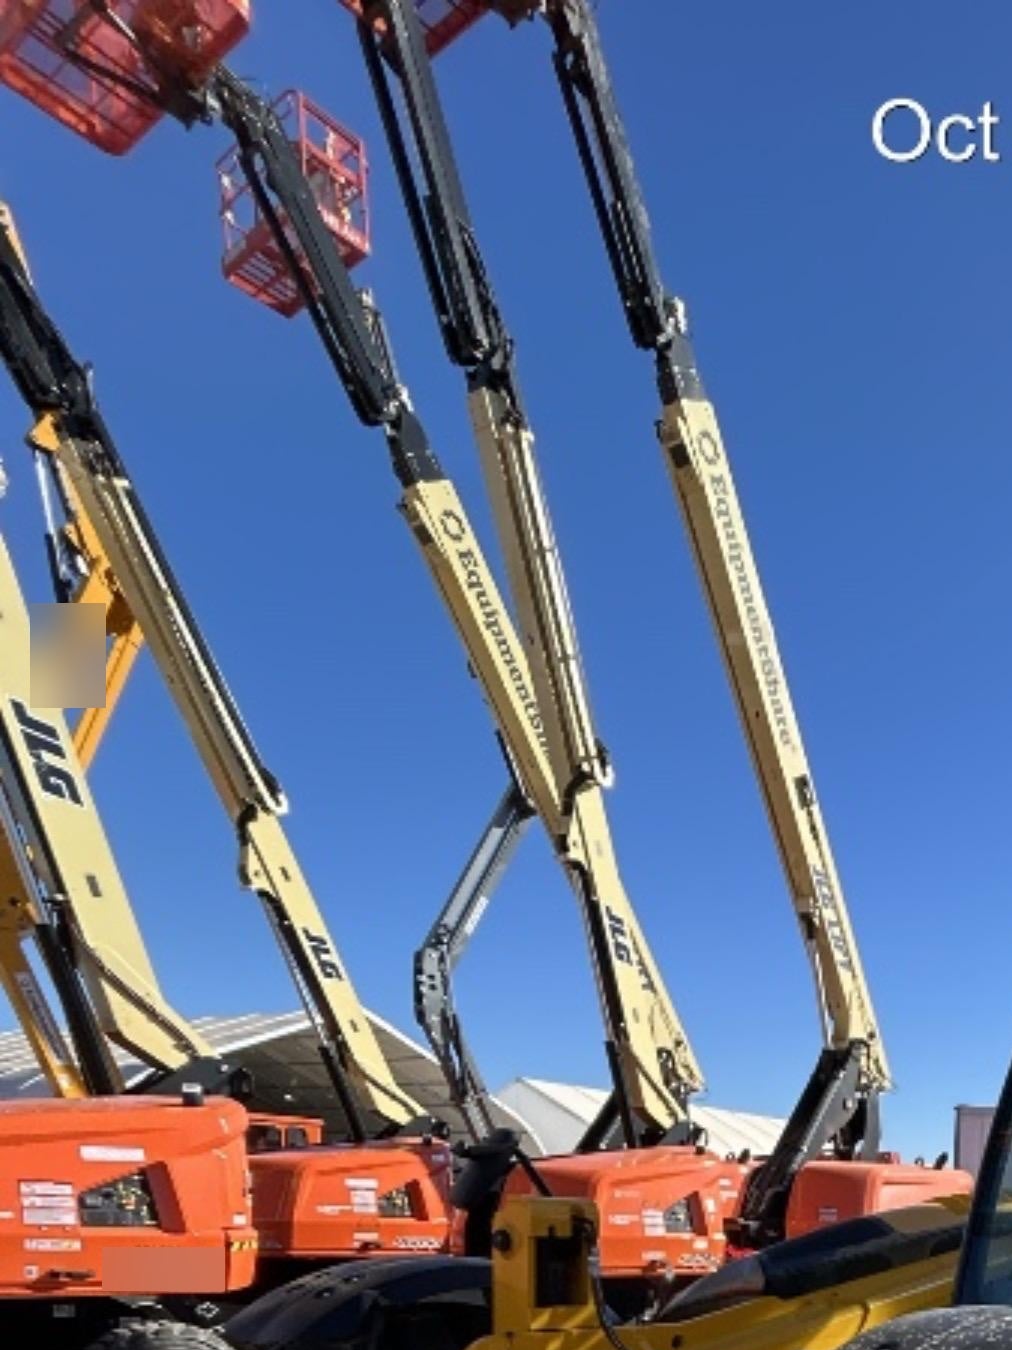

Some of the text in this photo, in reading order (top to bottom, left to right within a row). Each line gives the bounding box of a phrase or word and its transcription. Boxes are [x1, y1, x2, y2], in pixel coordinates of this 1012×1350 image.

[8, 698, 84, 807] JLG
[302, 927, 343, 981] JLG
[606, 905, 633, 966] JLG
